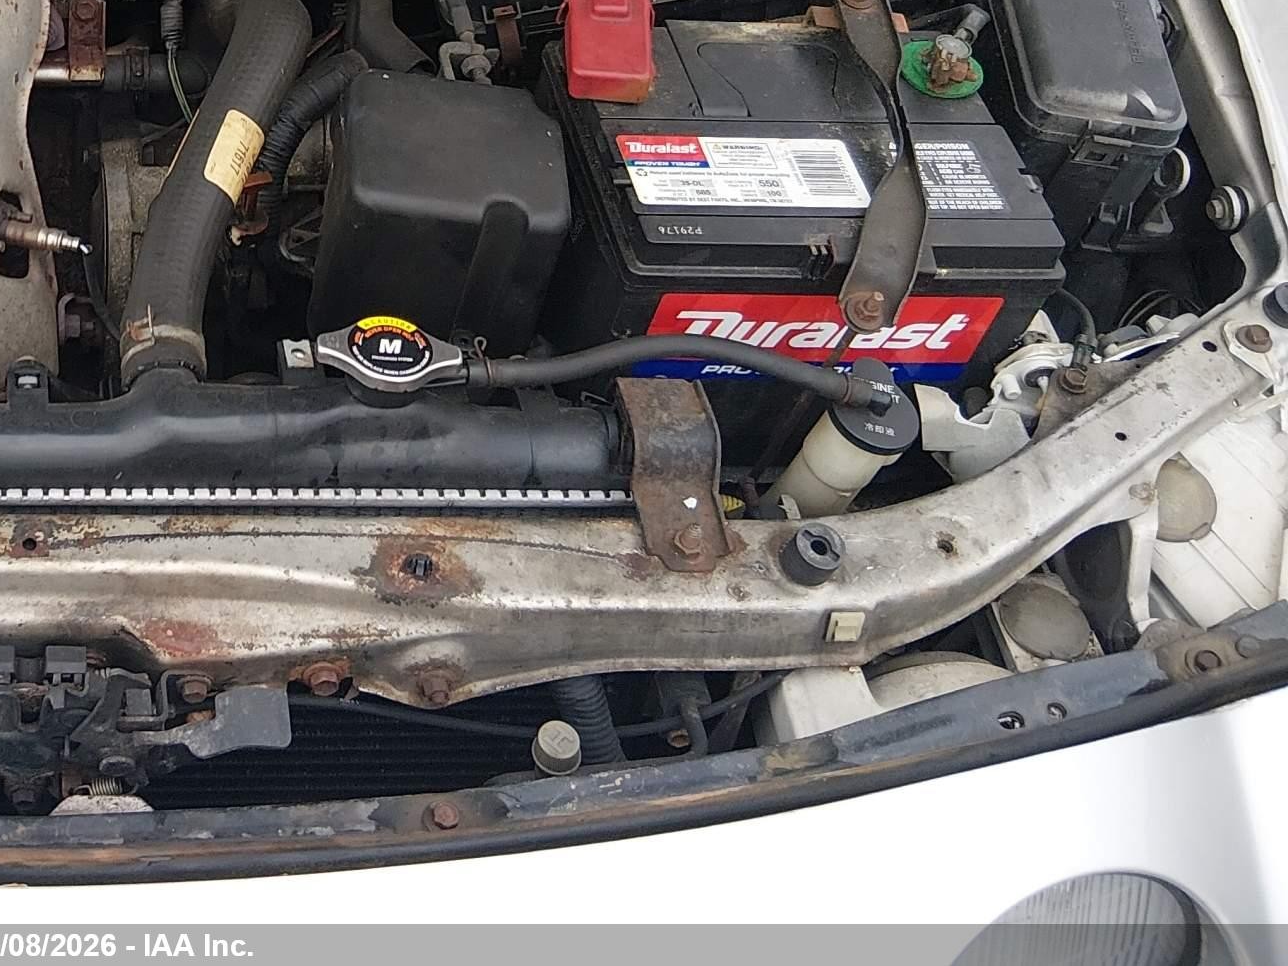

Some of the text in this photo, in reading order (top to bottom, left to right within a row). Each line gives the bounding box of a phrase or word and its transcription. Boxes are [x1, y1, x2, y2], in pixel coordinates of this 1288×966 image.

[624, 141, 697, 153] Duralast
[758, 179, 779, 187] 550
[378, 338, 402, 354] M
